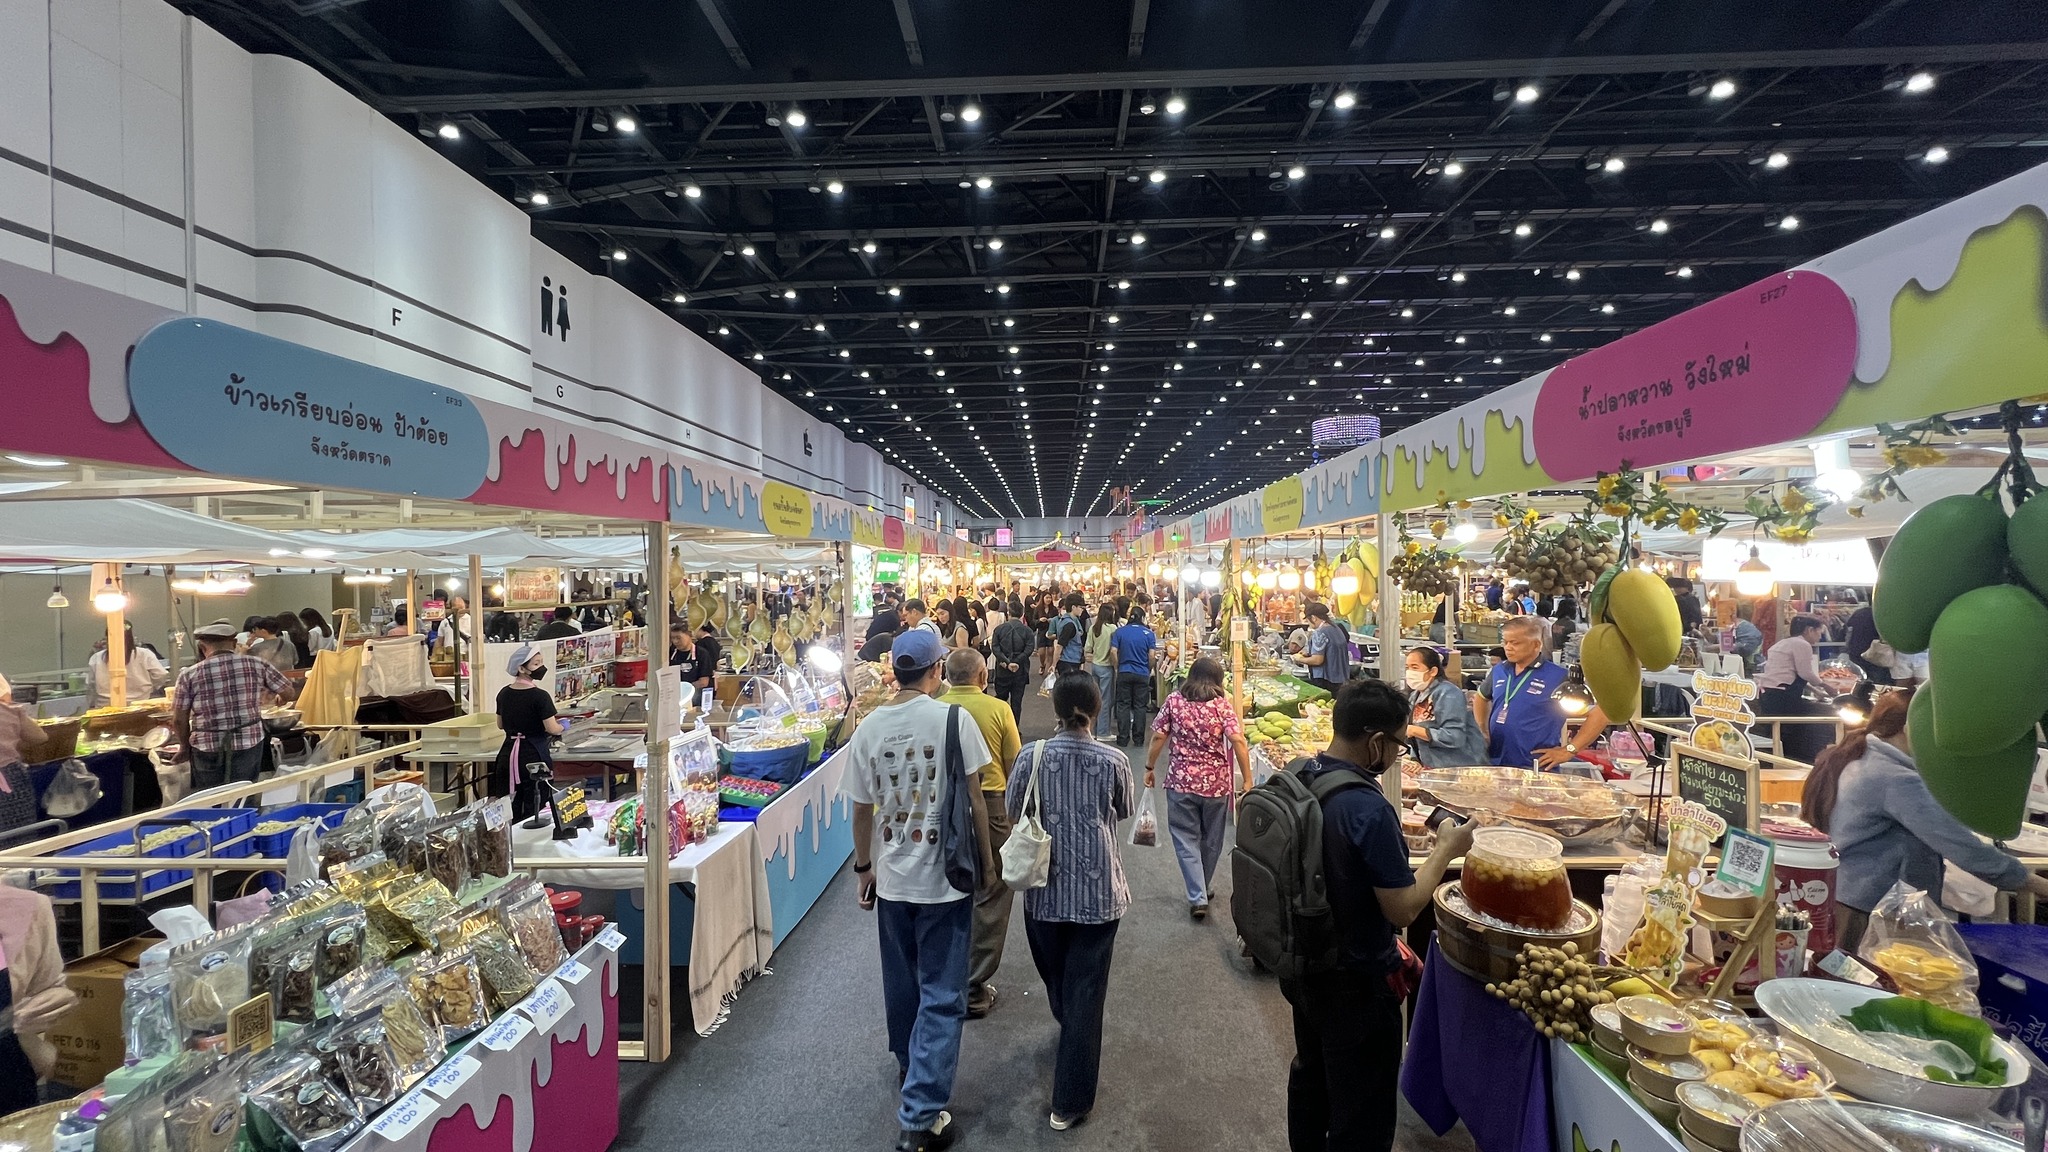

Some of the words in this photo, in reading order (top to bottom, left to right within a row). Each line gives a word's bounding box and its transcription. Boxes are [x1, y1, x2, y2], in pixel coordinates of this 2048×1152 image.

[1759, 285, 1788, 304] EF27
[391, 307, 403, 326] F
[1685, 341, 1750, 390] วังใหม่
[556, 385, 564, 398] G
[224, 372, 383, 433] ข้าวเกรียบอ่อน
[394, 412, 448, 446] ป้าต้อย
[445, 396, 463, 407] EF33
[685, 428, 691, 440] H
[1617, 409, 1692, 443] จังหวัดชลบุรี
[310, 436, 392, 467] จังหวัดตราด
[545, 1002, 559, 1018] 200
[502, 1028, 518, 1043] 100
[443, 1070, 460, 1085] 100
[398, 1110, 418, 1125] 100
